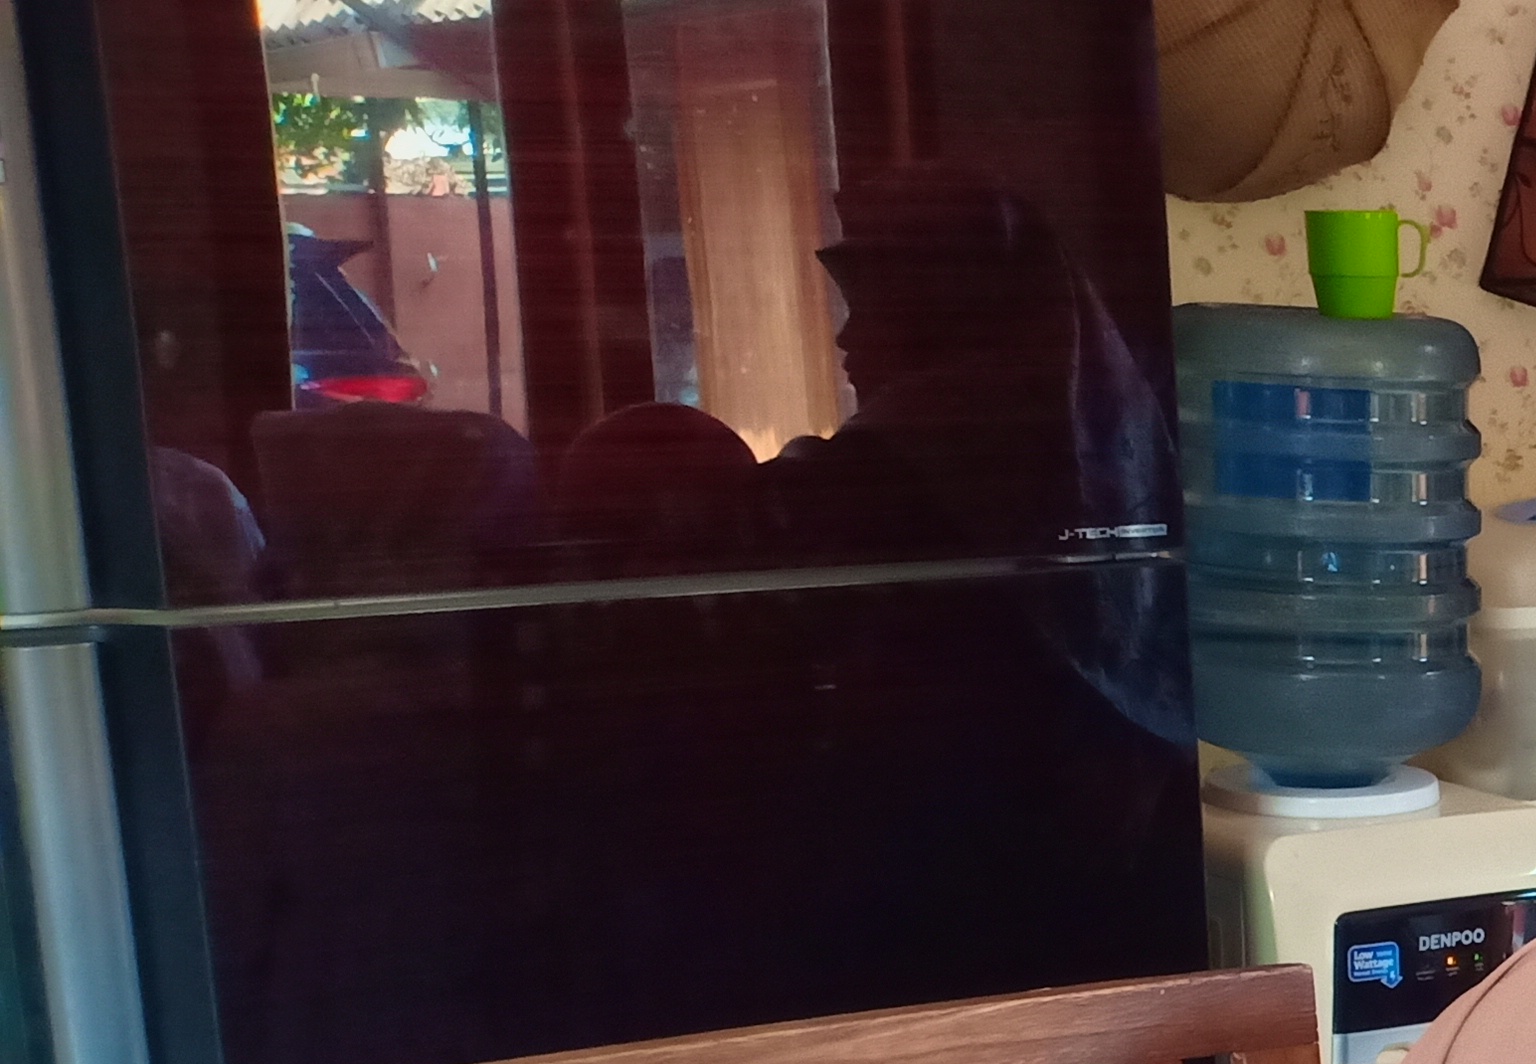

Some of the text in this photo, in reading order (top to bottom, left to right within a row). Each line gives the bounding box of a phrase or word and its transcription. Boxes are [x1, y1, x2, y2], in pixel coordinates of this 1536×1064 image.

[1058, 527, 1118, 540] J-TECH
[1418, 928, 1485, 951] DENPOO
[1353, 950, 1374, 960] Low
